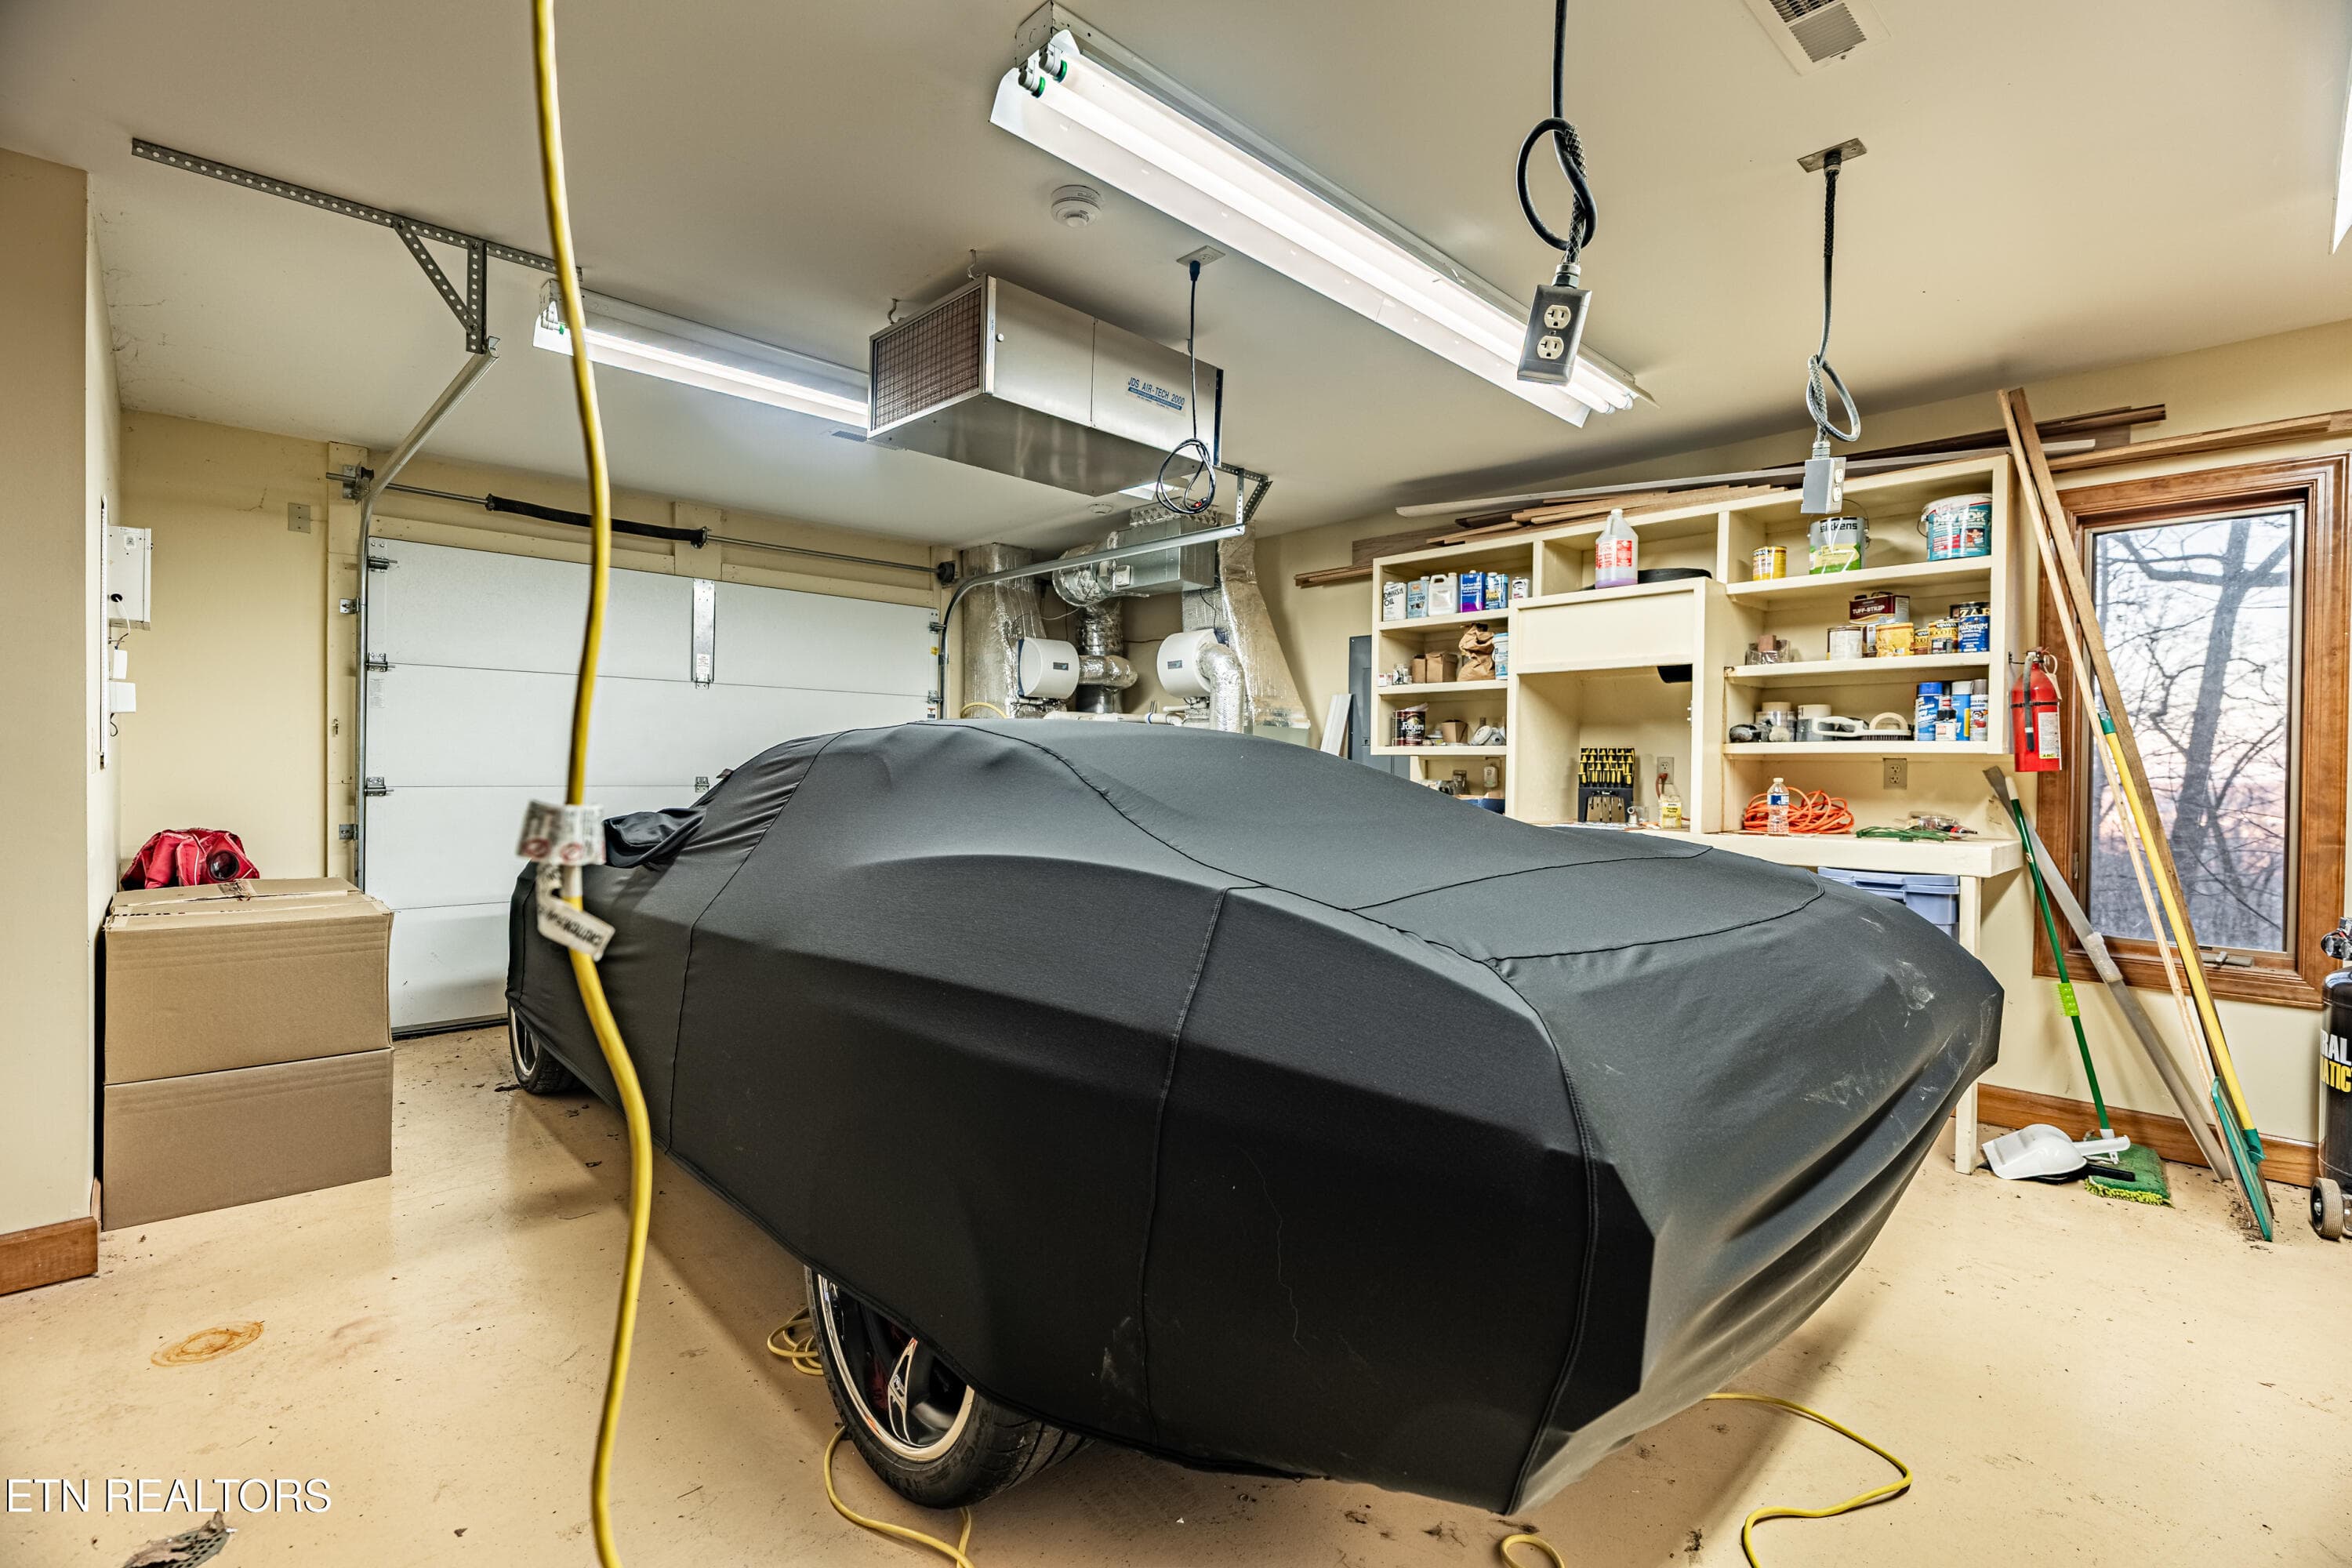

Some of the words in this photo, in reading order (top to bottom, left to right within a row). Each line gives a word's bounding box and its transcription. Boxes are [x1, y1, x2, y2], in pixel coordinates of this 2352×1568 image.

[1128, 377, 1139, 388] JDS
[1142, 383, 1169, 400] AIR-TECH
[1171, 394, 1185, 405] 2000
[1933, 510, 1987, 524] DRYOK
[1384, 598, 1394, 607] OIL
[1852, 604, 1886, 615] TUFF-STRIP
[1401, 721, 1425, 731] Folgers
